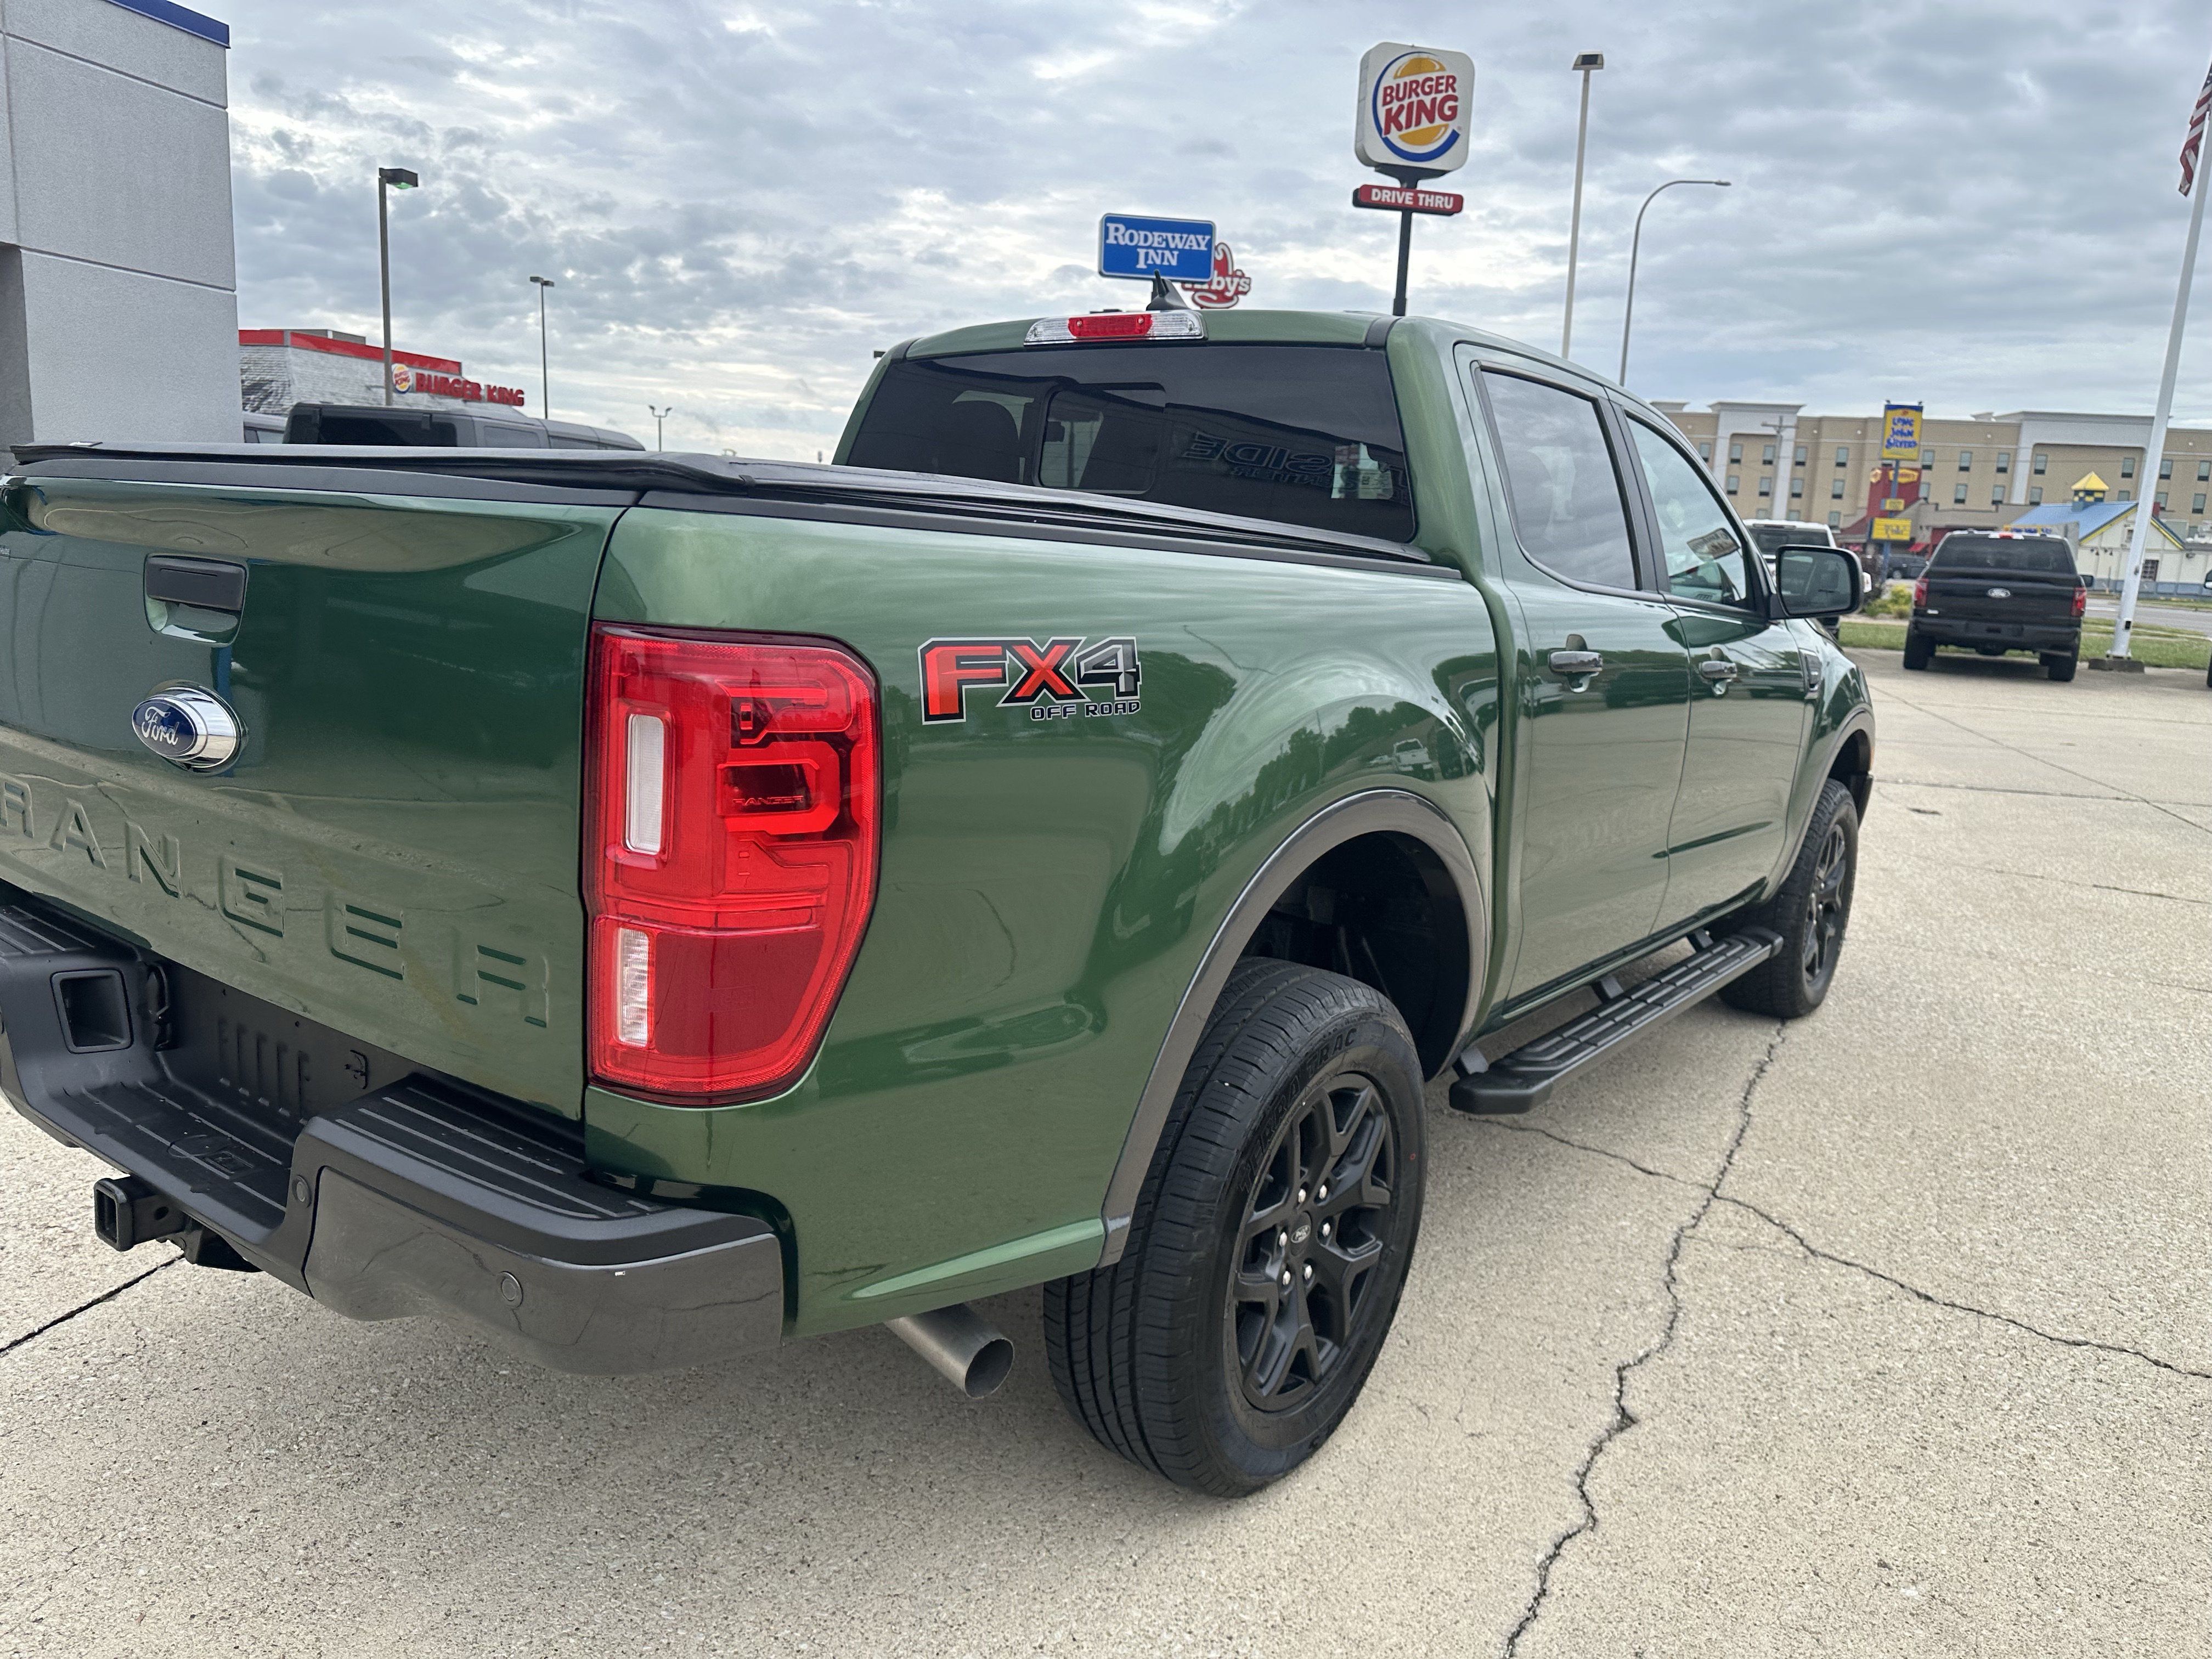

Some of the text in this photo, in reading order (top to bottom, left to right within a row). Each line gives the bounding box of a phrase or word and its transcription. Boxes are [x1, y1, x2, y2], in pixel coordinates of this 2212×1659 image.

[1382, 75, 1457, 106] BURGER
[1383, 94, 1459, 136] KING
[1372, 188, 1454, 209] DRIVE THRU
[1106, 223, 1210, 251] RODEWAY
[1136, 249, 1179, 269] INN
[1184, 270, 1250, 297] by's
[416, 373, 524, 406] BURGER KING
[917, 636, 1142, 725] FX4
[142, 706, 180, 746] Ford
[1030, 701, 1141, 721] OFF ROAD
[0, 772, 549, 1028] RANGER
